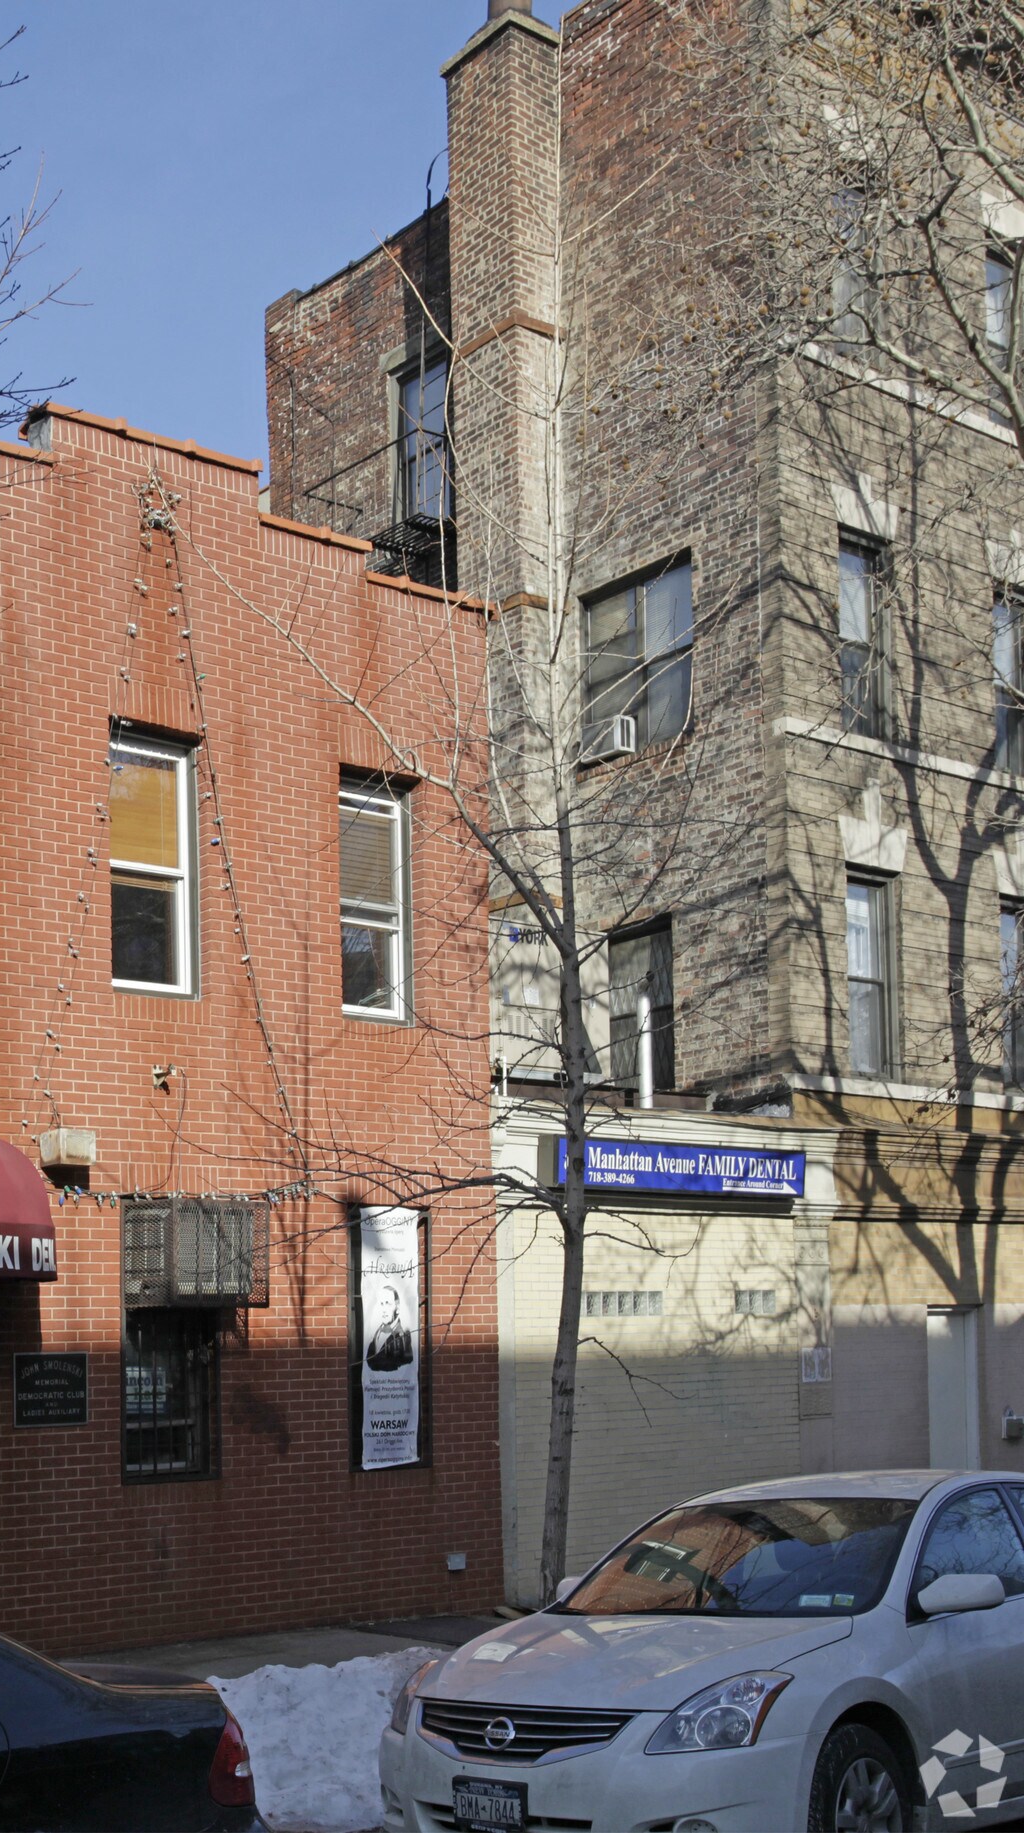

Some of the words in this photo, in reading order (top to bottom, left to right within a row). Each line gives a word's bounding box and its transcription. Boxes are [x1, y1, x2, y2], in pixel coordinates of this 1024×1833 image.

[519, 927, 549, 947] YORK
[588, 1147, 653, 1172] Manhattan
[654, 1152, 696, 1175] Avenue
[698, 1154, 747, 1177] FAMILY
[748, 1157, 797, 1180] DENTAL
[588, 1171, 635, 1184] 718-389-4266
[723, 1178, 746, 1188] Entrance
[747, 1180, 766, 1189] Around
[766, 1180, 784, 1189] Corner
[21, 1363, 40, 1379] JOHN
[43, 1360, 83, 1378] SMOLENSKI
[18, 1392, 64, 1400] DEMOCRATIC
[66, 1391, 85, 1399] CLUB
[22, 1409, 45, 1417] LADIES
[48, 1408, 80, 1416] AUXILIARY
[370, 1419, 409, 1430] WARSAW
